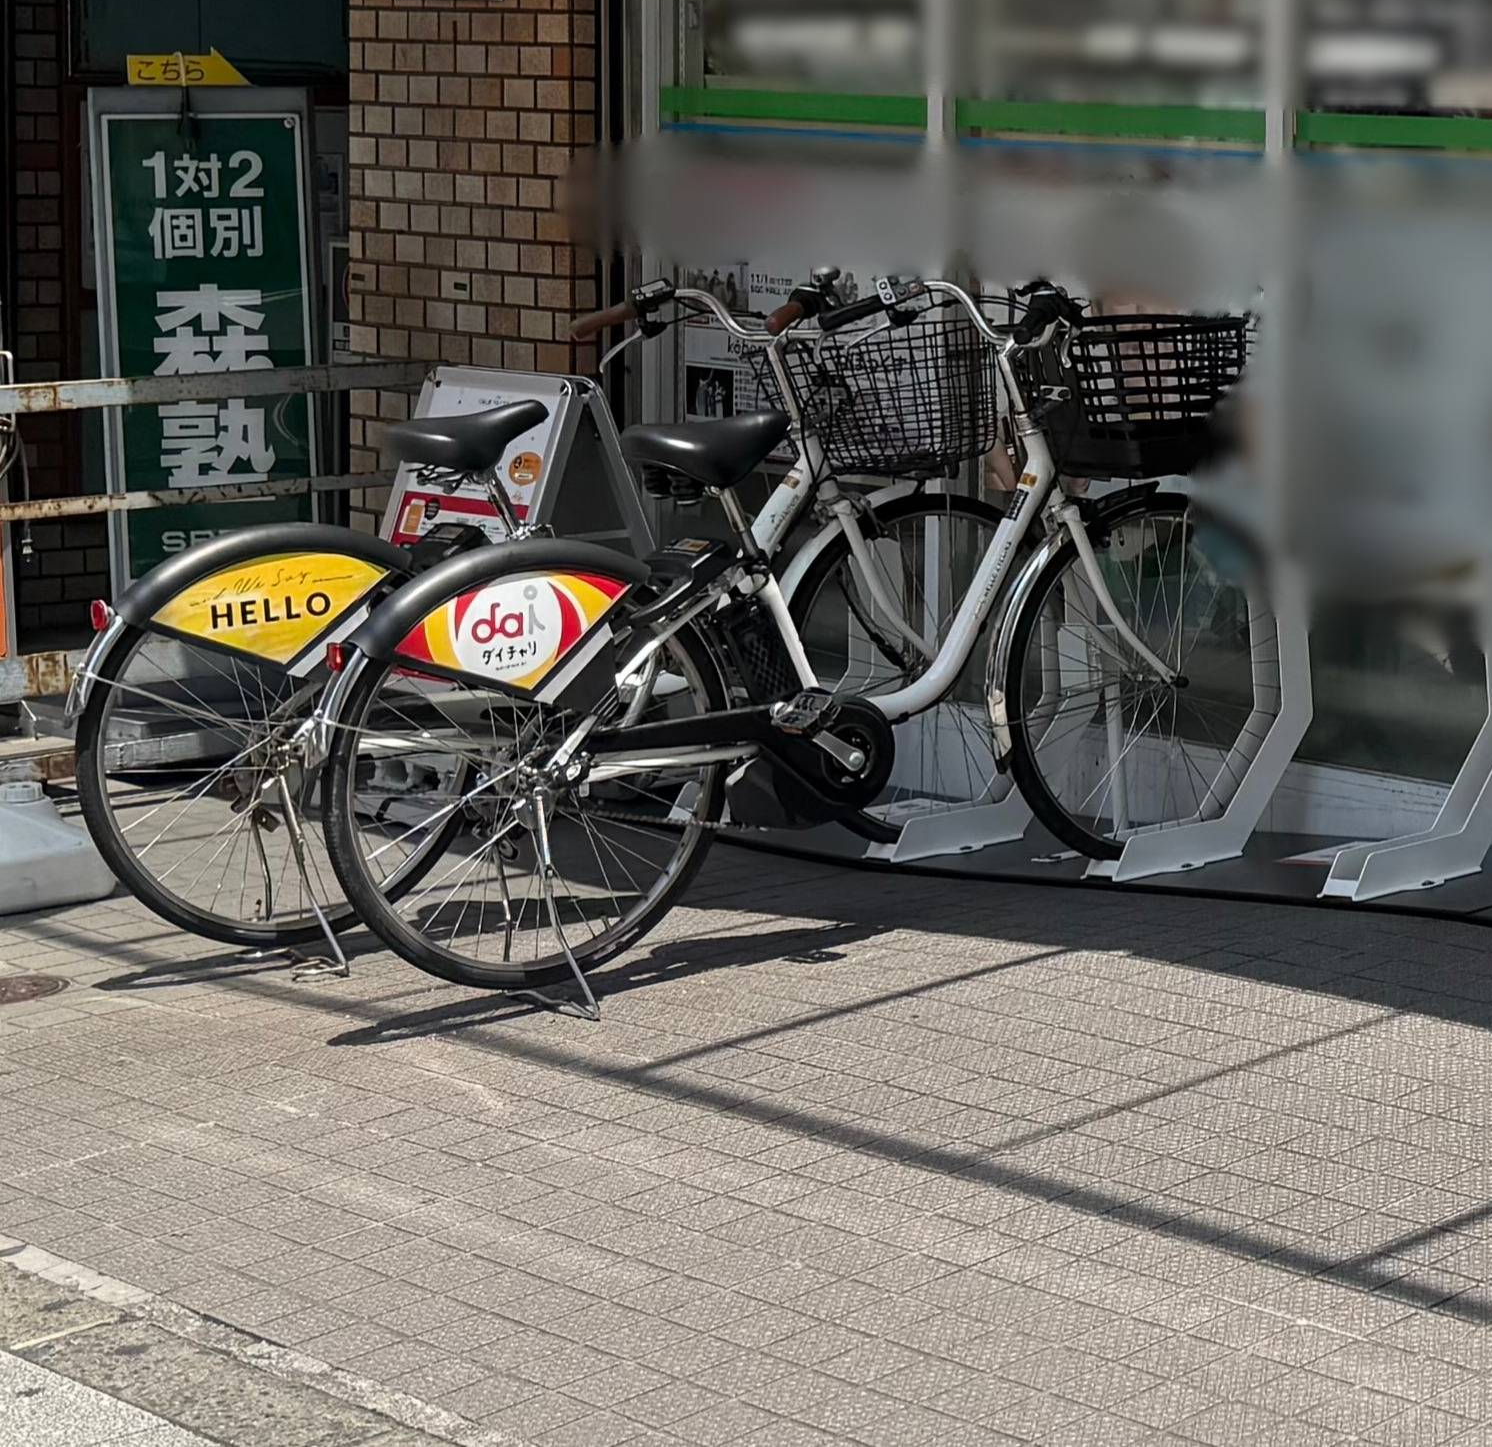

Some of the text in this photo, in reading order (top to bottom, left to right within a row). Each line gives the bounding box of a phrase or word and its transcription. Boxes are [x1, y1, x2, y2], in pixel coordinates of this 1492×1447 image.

[136, 58, 205, 83] こちら
[141, 149, 265, 199] 1対2
[147, 205, 265, 260] 個別
[153, 283, 276, 489] 森塾
[210, 590, 332, 630] HELLO
[481, 639, 538, 666] ダイチャリ
